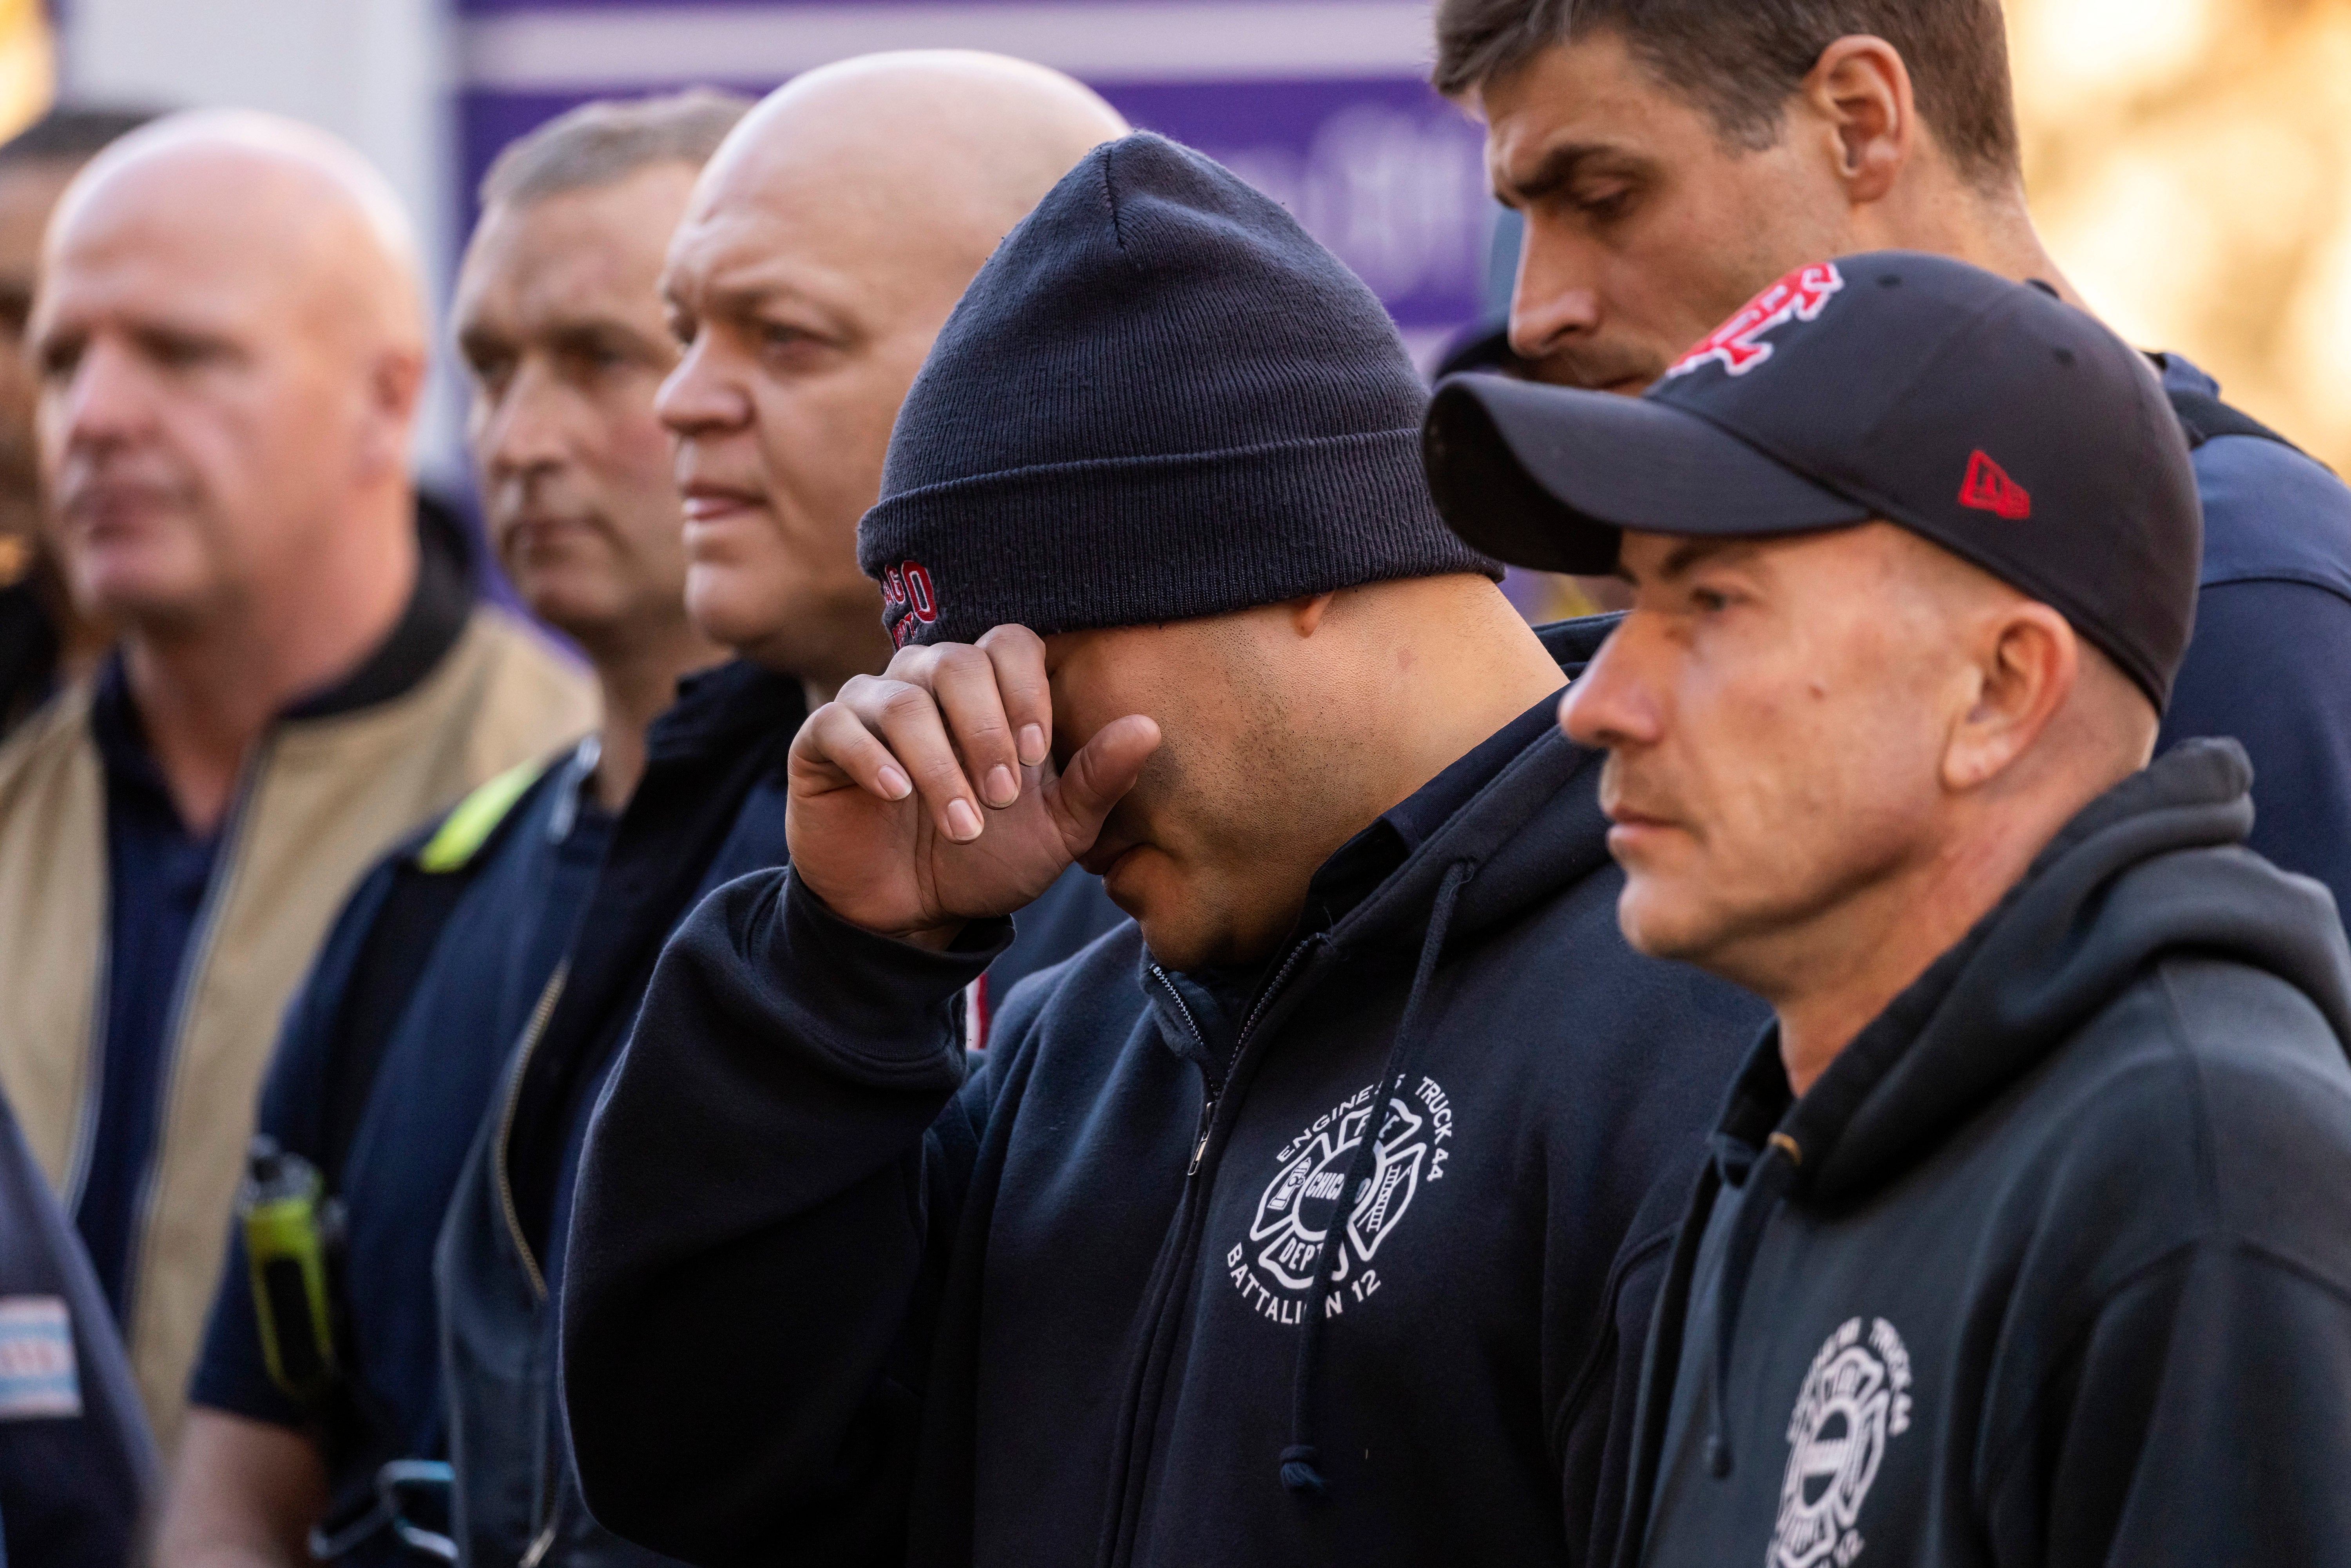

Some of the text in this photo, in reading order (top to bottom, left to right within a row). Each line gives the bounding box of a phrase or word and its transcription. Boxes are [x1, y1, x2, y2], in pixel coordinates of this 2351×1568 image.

[1276, 1084, 1374, 1163] ENGINE
[1415, 1076, 1452, 1145] TRUCK
[1305, 1171, 1372, 1204] CHICO
[1426, 1148, 1449, 1182] 44
[1227, 1242, 1382, 1324] BATTALIN 12
